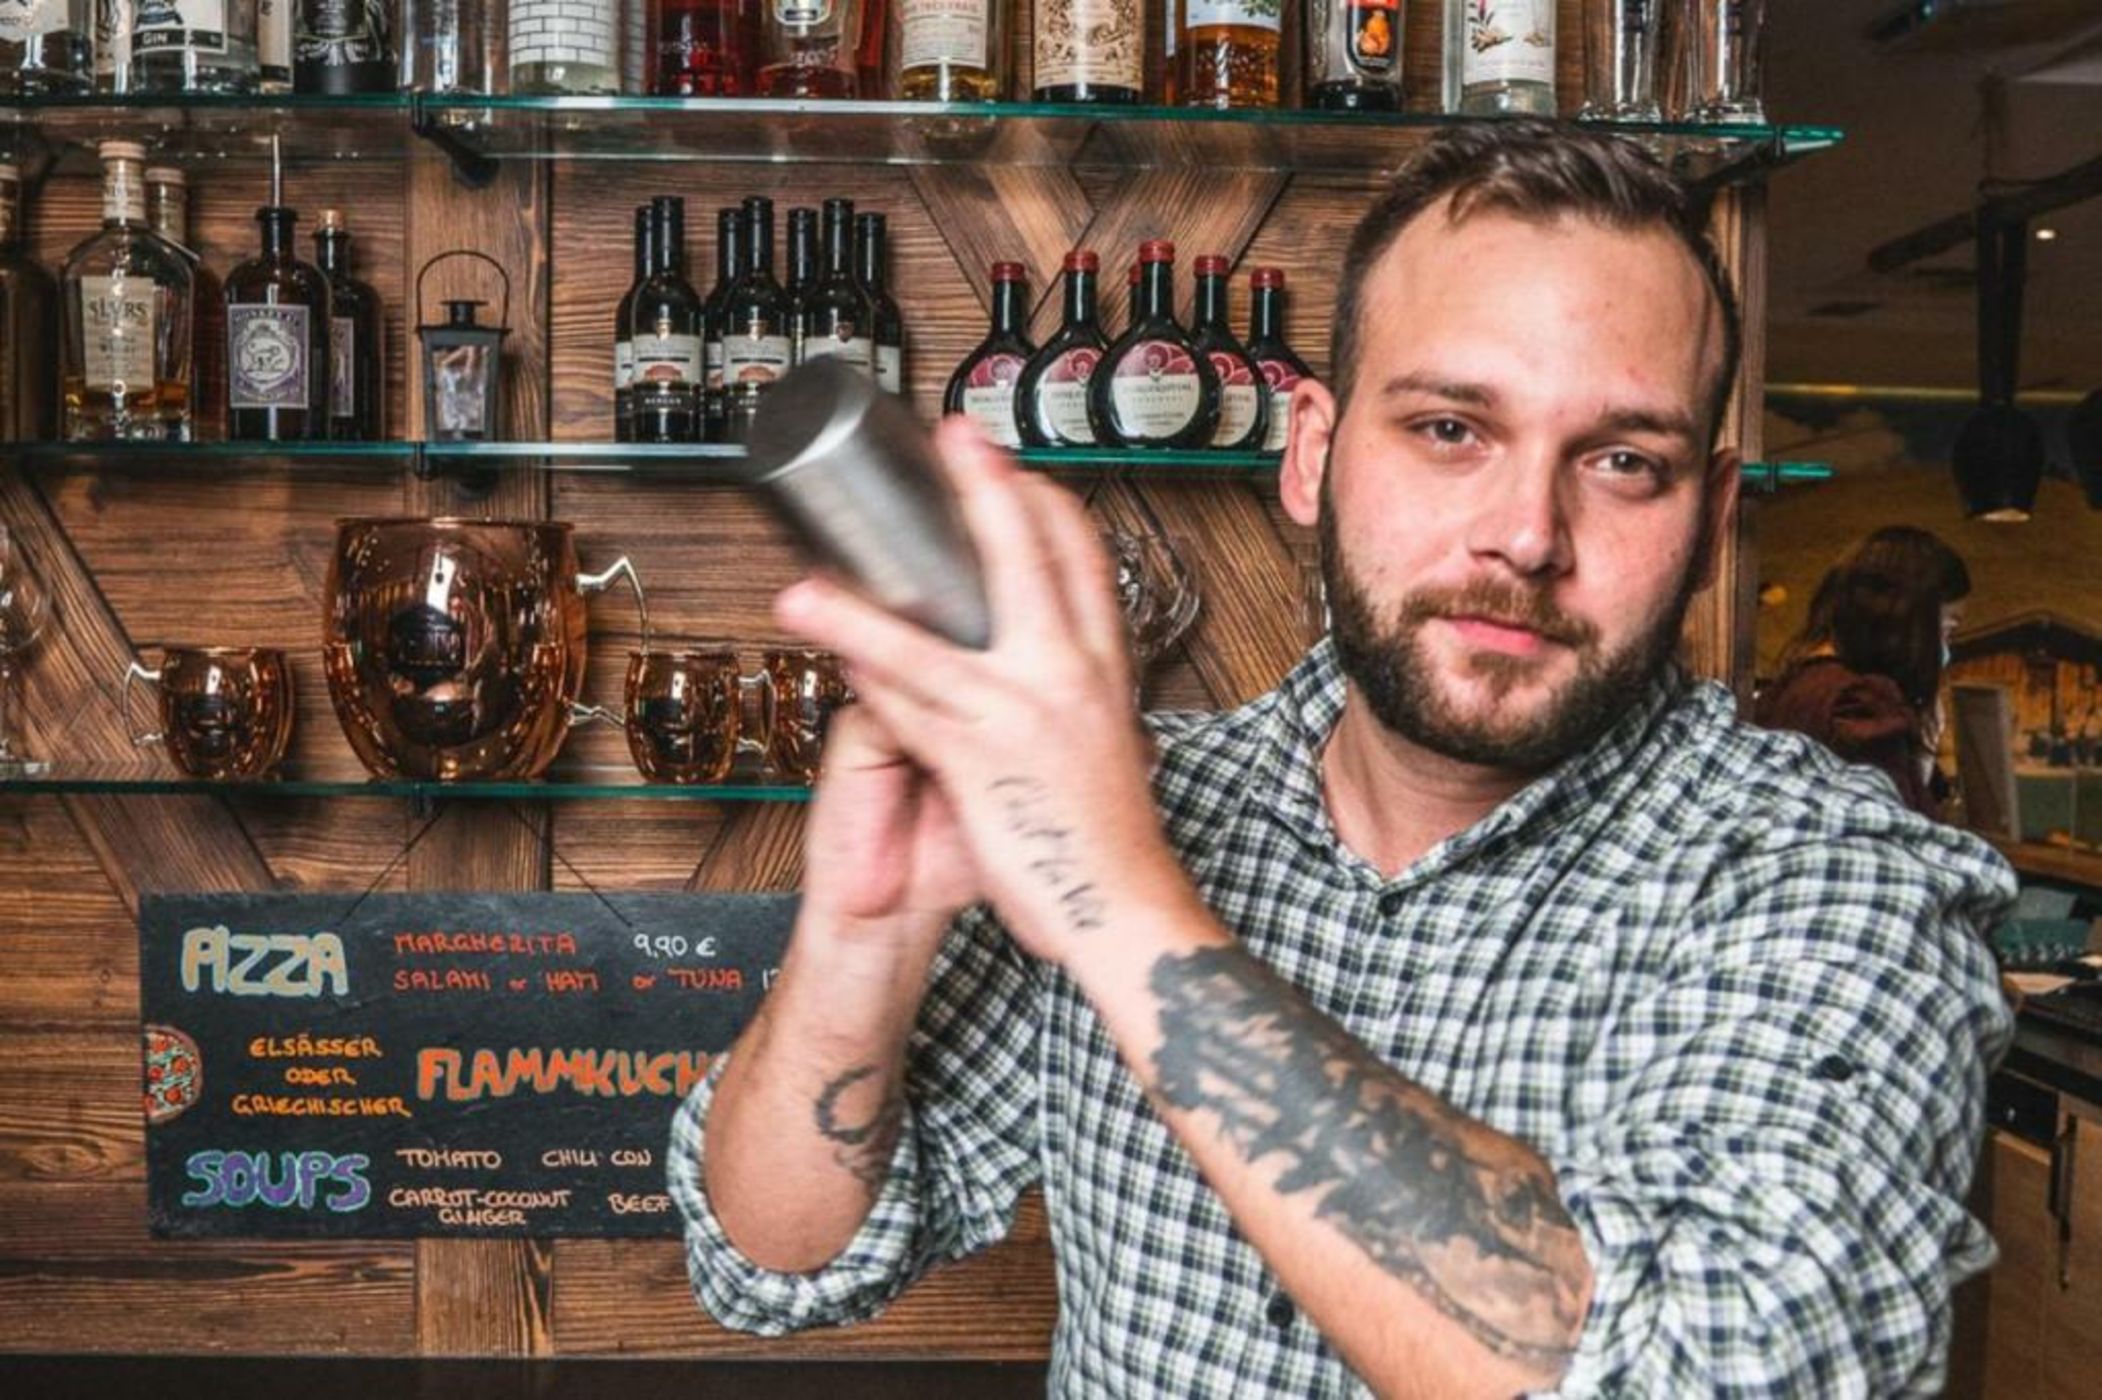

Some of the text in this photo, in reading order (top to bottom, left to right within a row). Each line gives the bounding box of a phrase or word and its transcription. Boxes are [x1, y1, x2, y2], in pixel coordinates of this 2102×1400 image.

[143, 32, 168, 45] GIN
[394, 932, 717, 959] MARGHERITA 9,90 €
[393, 969, 491, 991] SALAMI
[545, 970, 600, 991] HAM
[667, 968, 743, 990] TUNA
[285, 1065, 358, 1086] ODER
[231, 1094, 413, 1118] GRIECHISCHER
[396, 1149, 652, 1169] TOMATO CHILI CON
[181, 1150, 371, 1212] SOUPS
[388, 1187, 671, 1215] CARROT-COCONUT BEEF
[438, 1208, 528, 1226] GINGER
